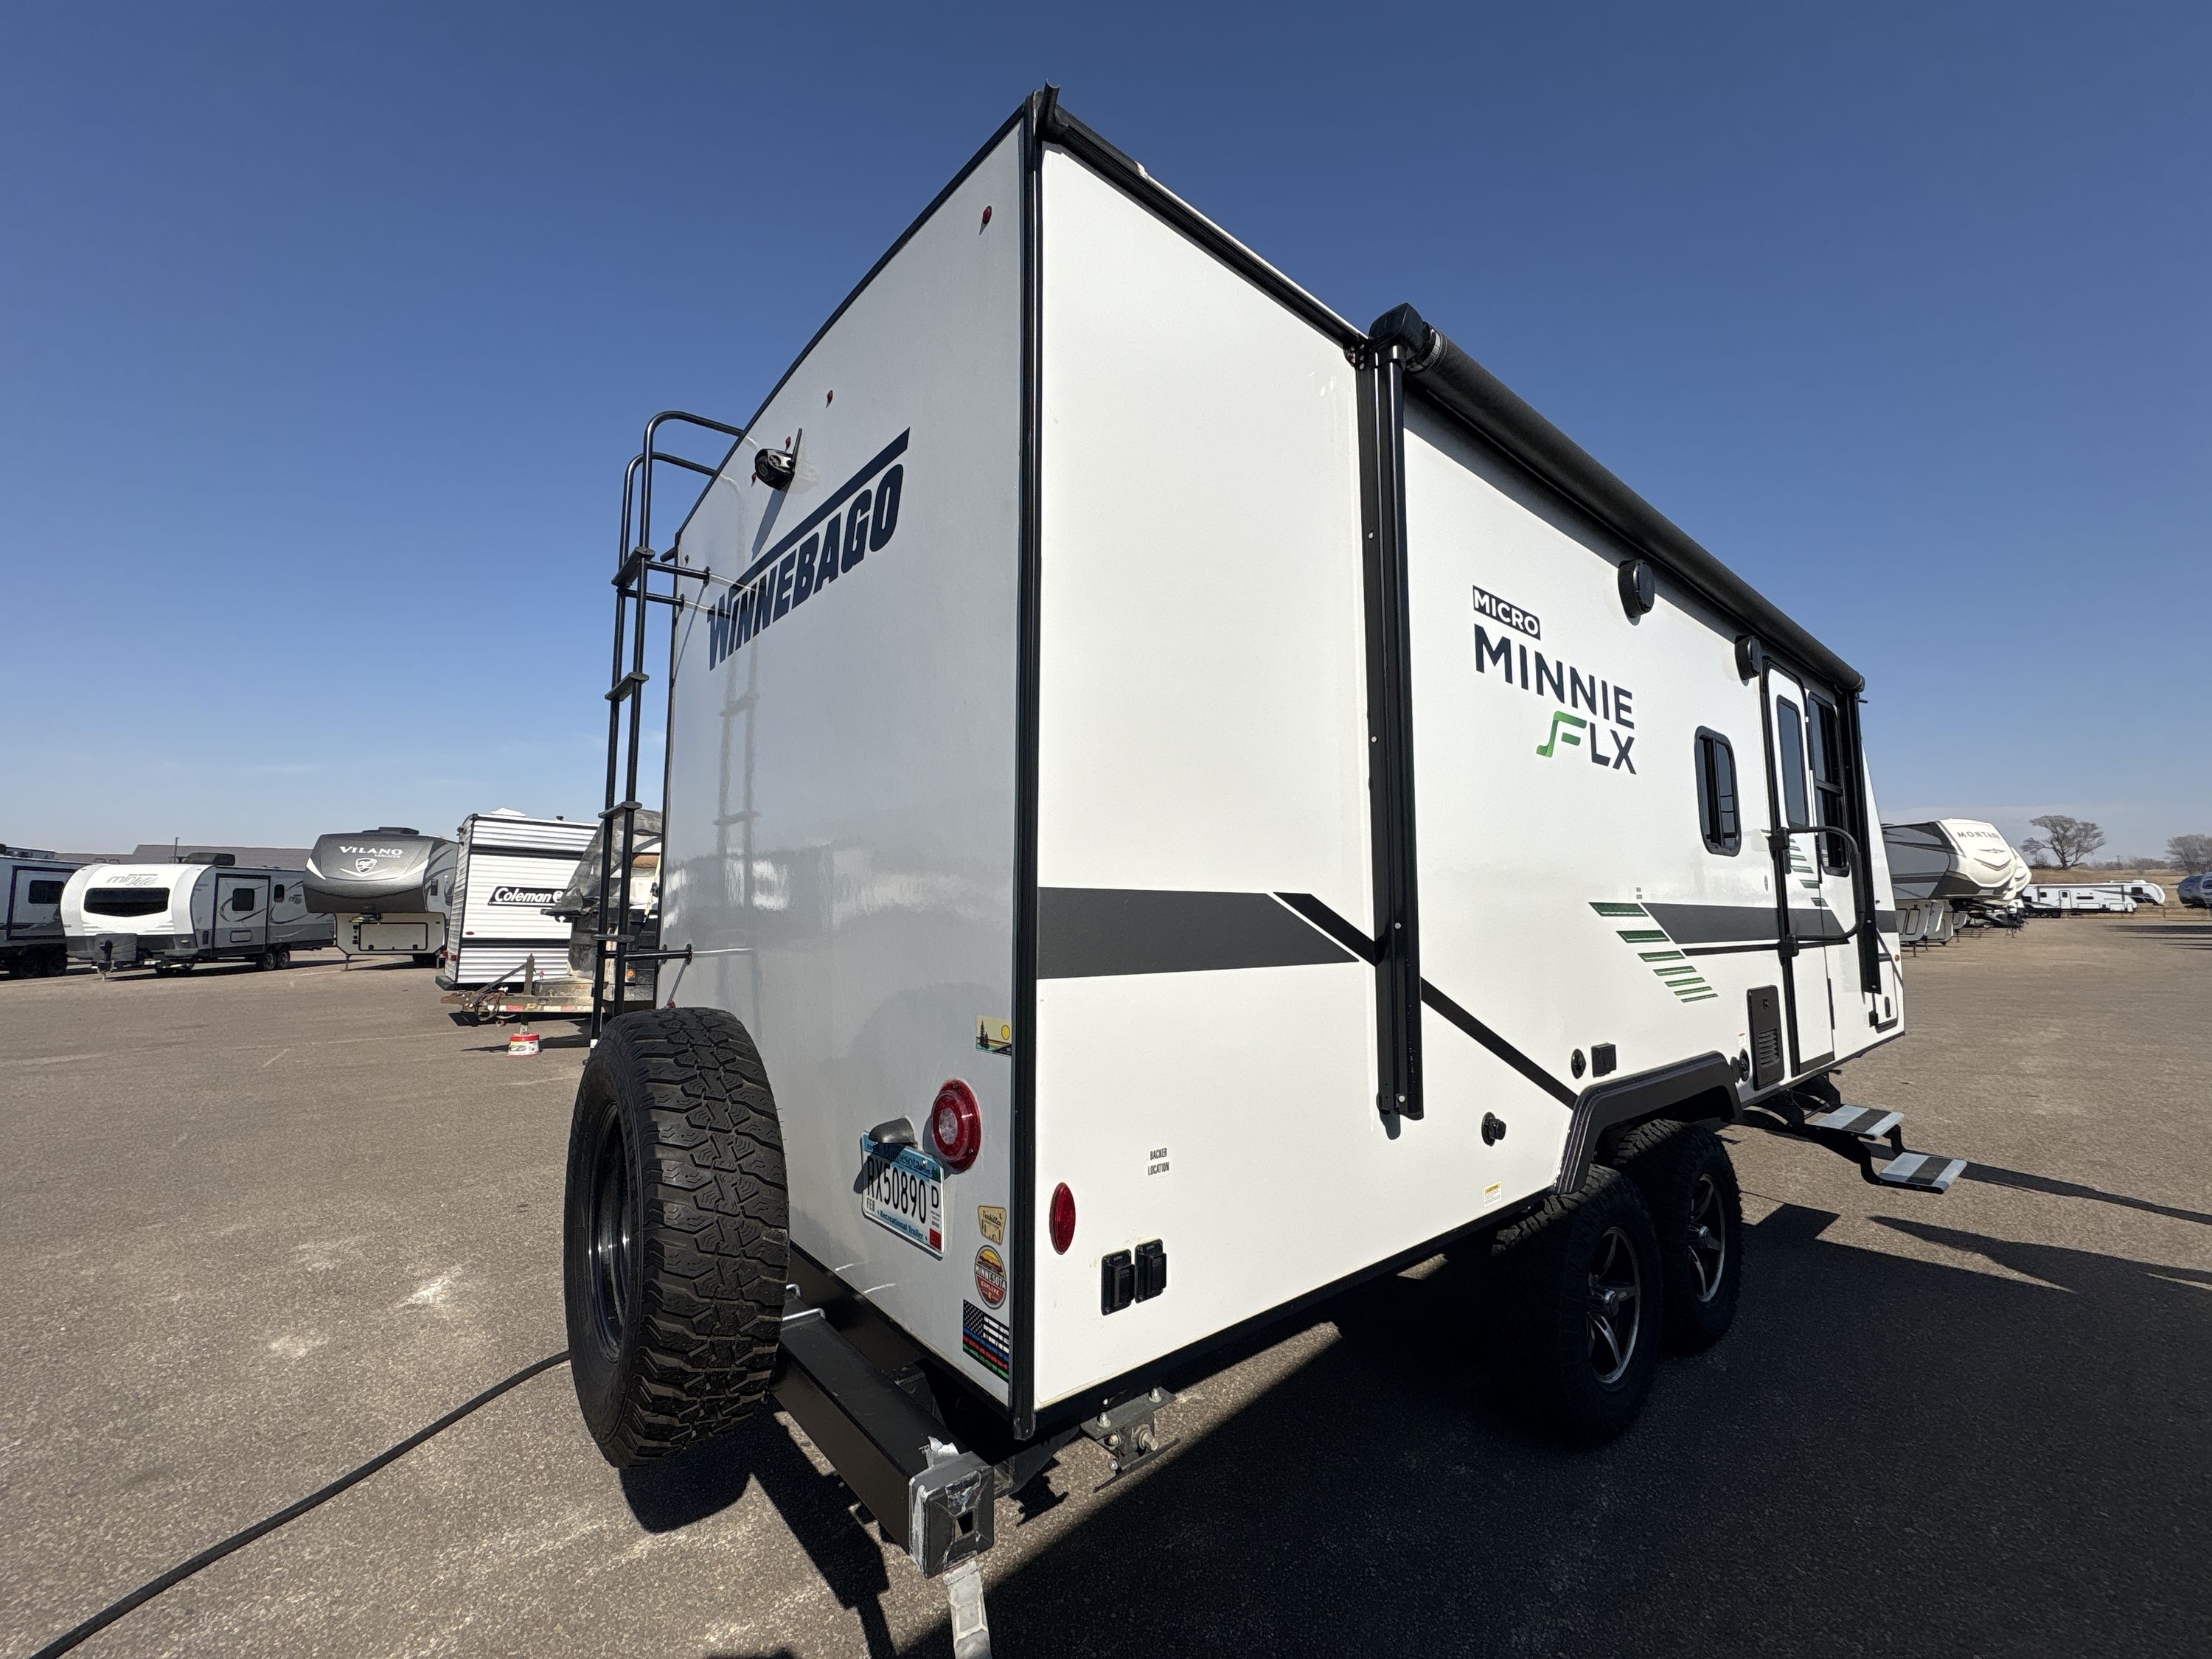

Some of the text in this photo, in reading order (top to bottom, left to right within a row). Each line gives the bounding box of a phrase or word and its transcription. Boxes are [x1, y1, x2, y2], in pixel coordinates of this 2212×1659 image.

[706, 463, 905, 672] WINNEBAGO
[1474, 588, 1540, 636] MICRO
[1474, 622, 1635, 730] MINNIE
[1535, 710, 1637, 776] FLX
[339, 846, 403, 855] VILANO
[494, 887, 552, 902] Coleman
[1147, 1161, 1170, 1176] LOCATION
[1150, 1147, 1168, 1161] BACKER
[866, 1155, 928, 1224] RX50890
[931, 1183, 940, 1209] D
[866, 1197, 876, 1212] FEB
[879, 1209, 908, 1233] Recreational
[907, 1224, 925, 1240] Trailer
[975, 1263, 1006, 1290] MINNESOTA
